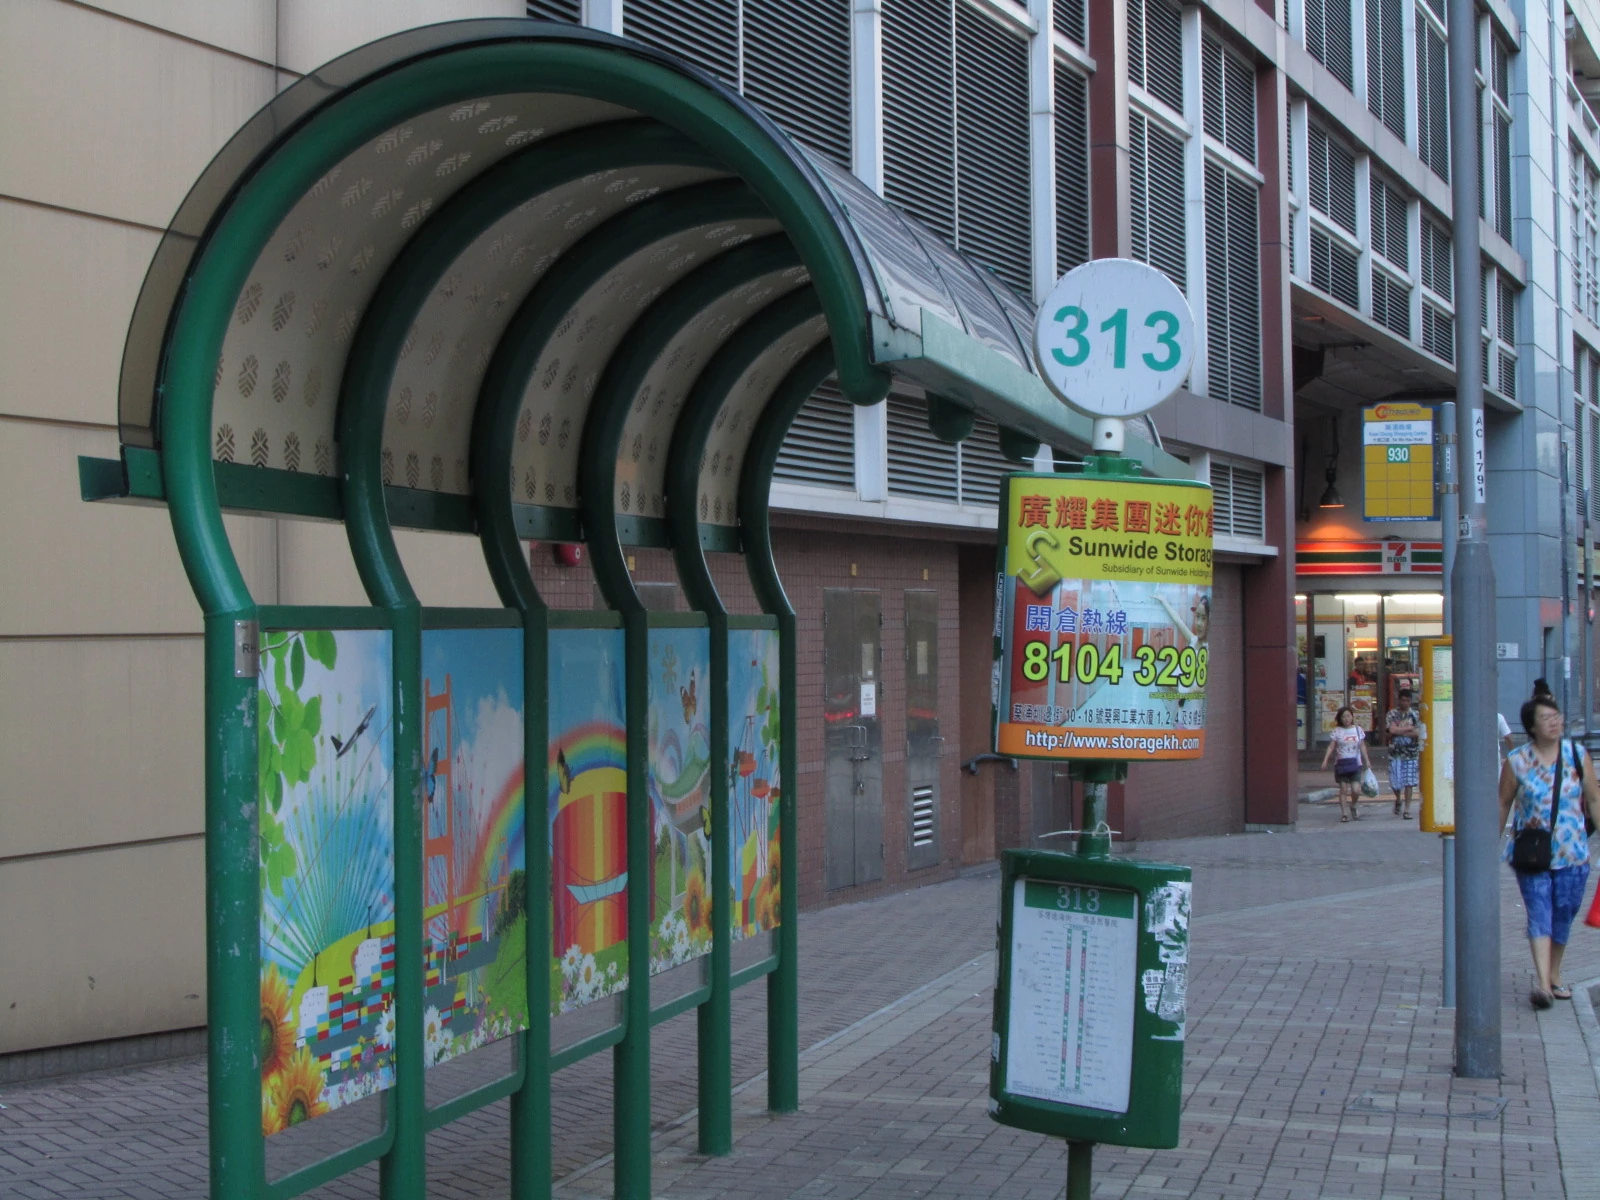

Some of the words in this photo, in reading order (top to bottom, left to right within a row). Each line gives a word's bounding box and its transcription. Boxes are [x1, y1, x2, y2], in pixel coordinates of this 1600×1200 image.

[1050, 305, 1182, 372] 313
[1388, 447, 1409, 462] 930
[1476, 450, 1484, 497] 1791
[1068, 536, 1158, 561] Sunwide
[1388, 542, 1406, 572] 7
[1102, 563, 1144, 577] Subsidiary
[1146, 565, 1155, 574] of
[1156, 566, 1188, 577] Sunwide
[1026, 605, 1129, 635] 開倉熱線
[1022, 640, 1124, 686] 8104
[1133, 644, 1208, 688] 3298
[1066, 708, 1076, 723] 10
[1084, 708, 1094, 723] 18
[1026, 730, 1200, 753] http://www.storagekh.com
[1056, 885, 1101, 913] 313
